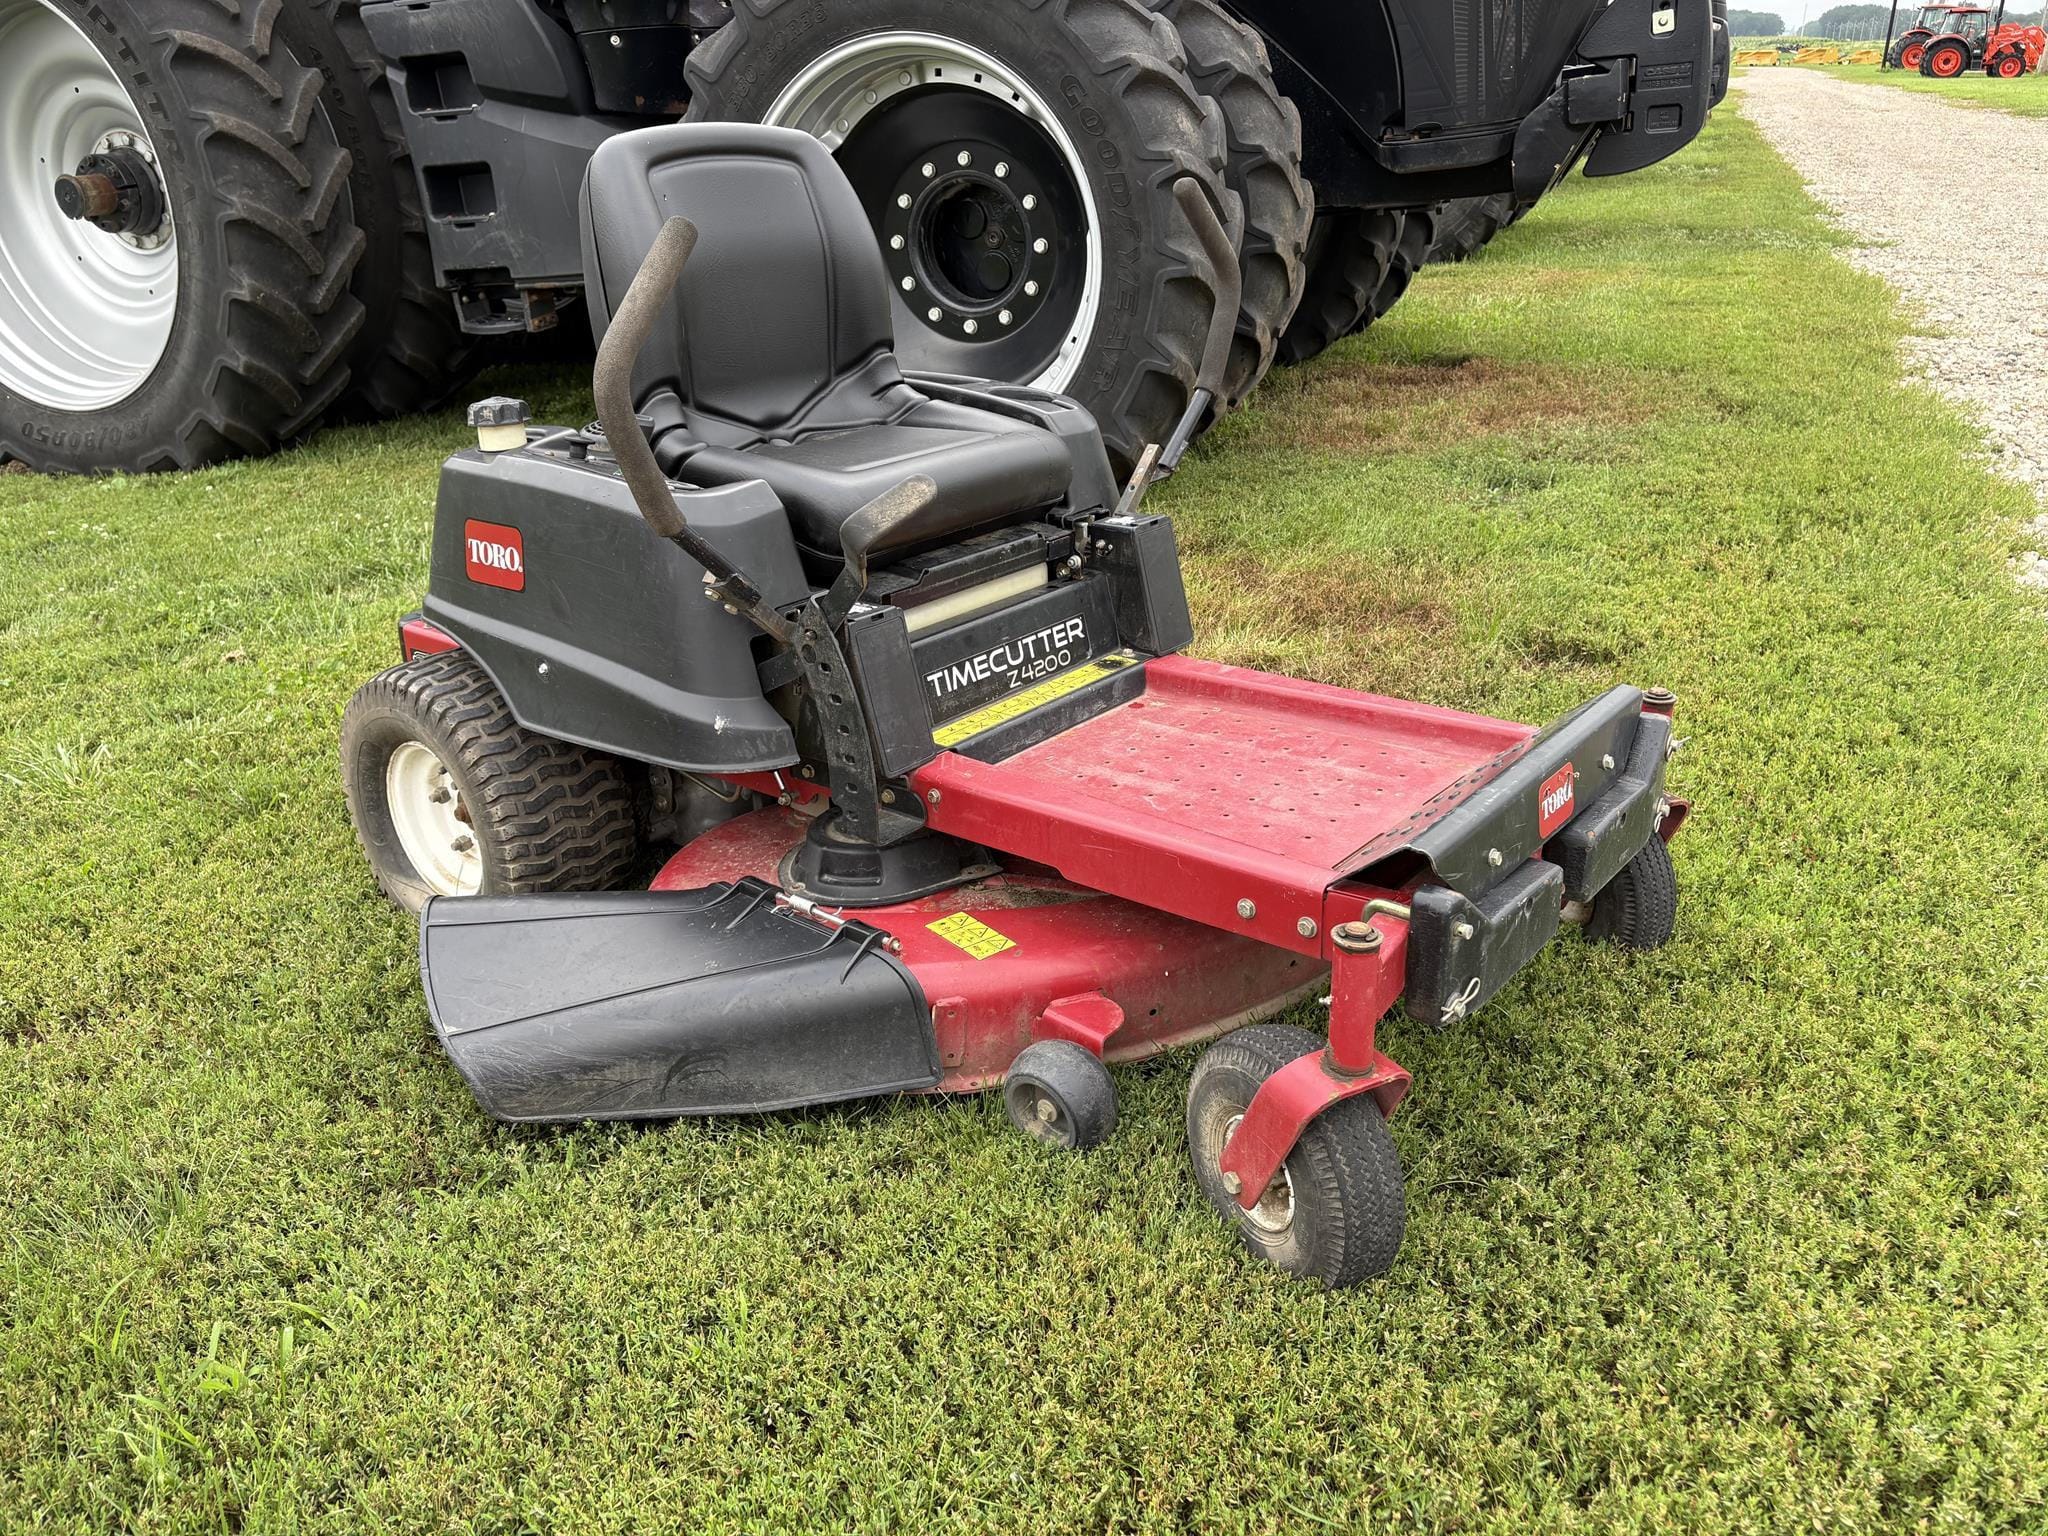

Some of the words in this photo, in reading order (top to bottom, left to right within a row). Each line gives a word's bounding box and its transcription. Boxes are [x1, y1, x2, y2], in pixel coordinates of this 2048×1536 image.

[467, 538, 521, 572] TORO
[926, 617, 1085, 697] TIMECUTTER
[1007, 649, 1071, 688] Z4200
[1541, 782, 1572, 820] TORO
